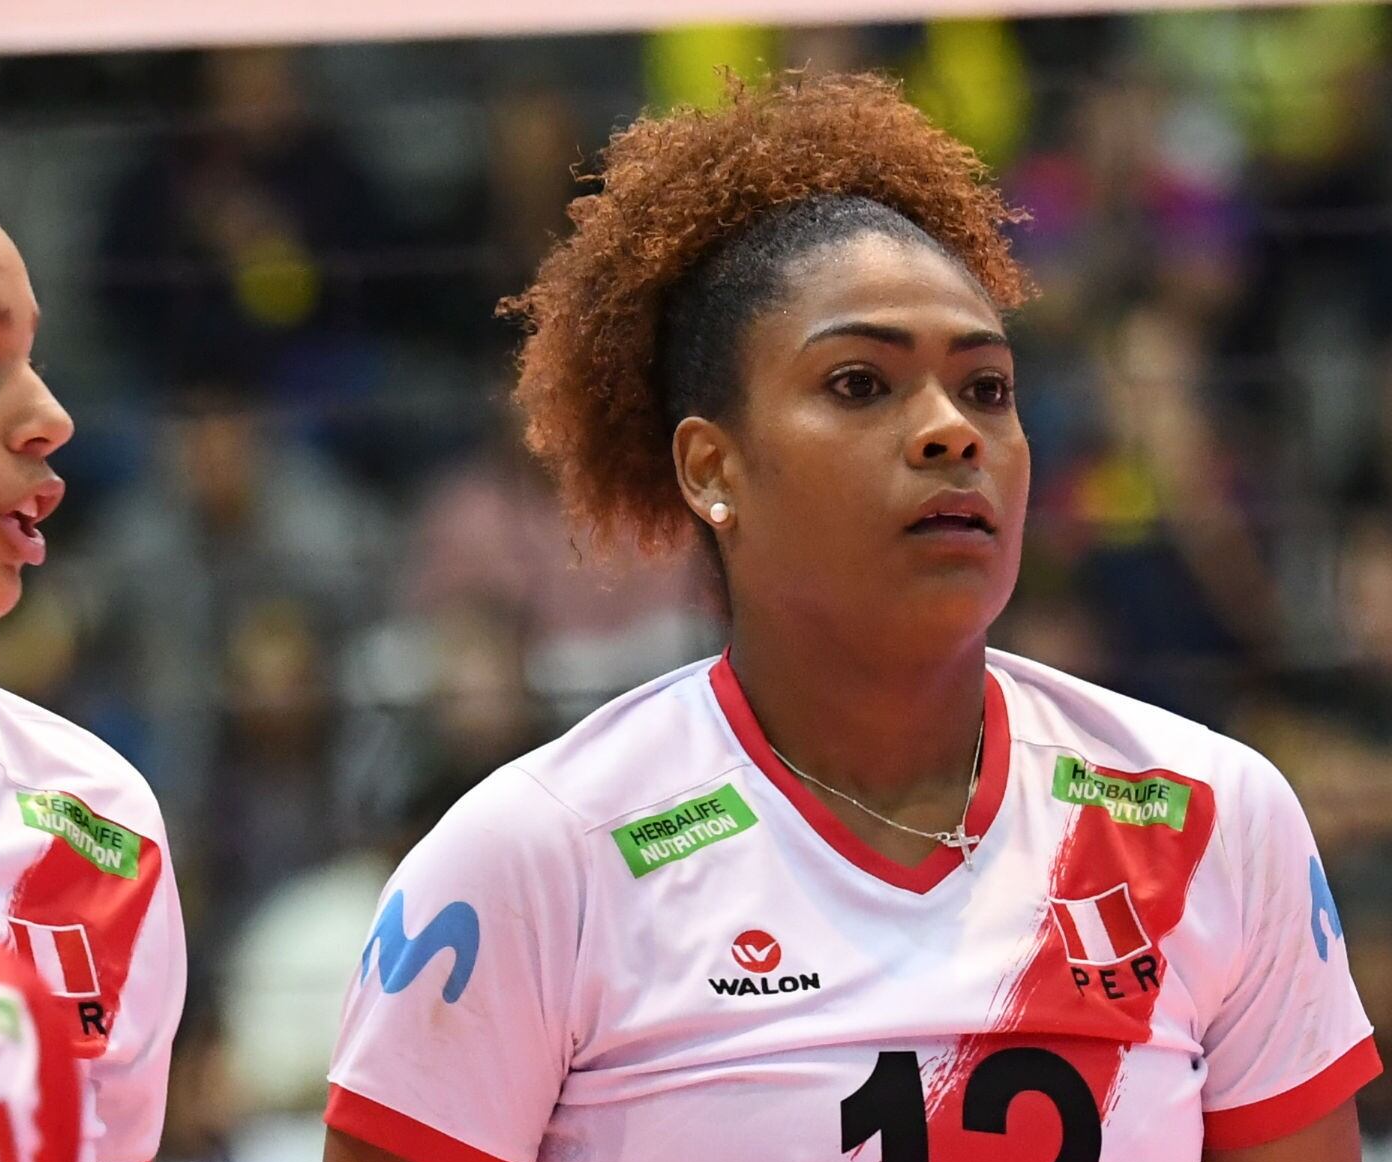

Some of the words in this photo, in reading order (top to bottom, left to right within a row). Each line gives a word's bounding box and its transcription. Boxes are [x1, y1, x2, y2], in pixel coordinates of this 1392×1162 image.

[1067, 781, 1169, 821] NURITION
[1071, 763, 1170, 804] HRBALIFE
[629, 798, 726, 846] HERBALIFE
[639, 814, 739, 865] NUTRITION
[708, 972, 821, 996] WALON
[1070, 955, 1160, 1000] PER
